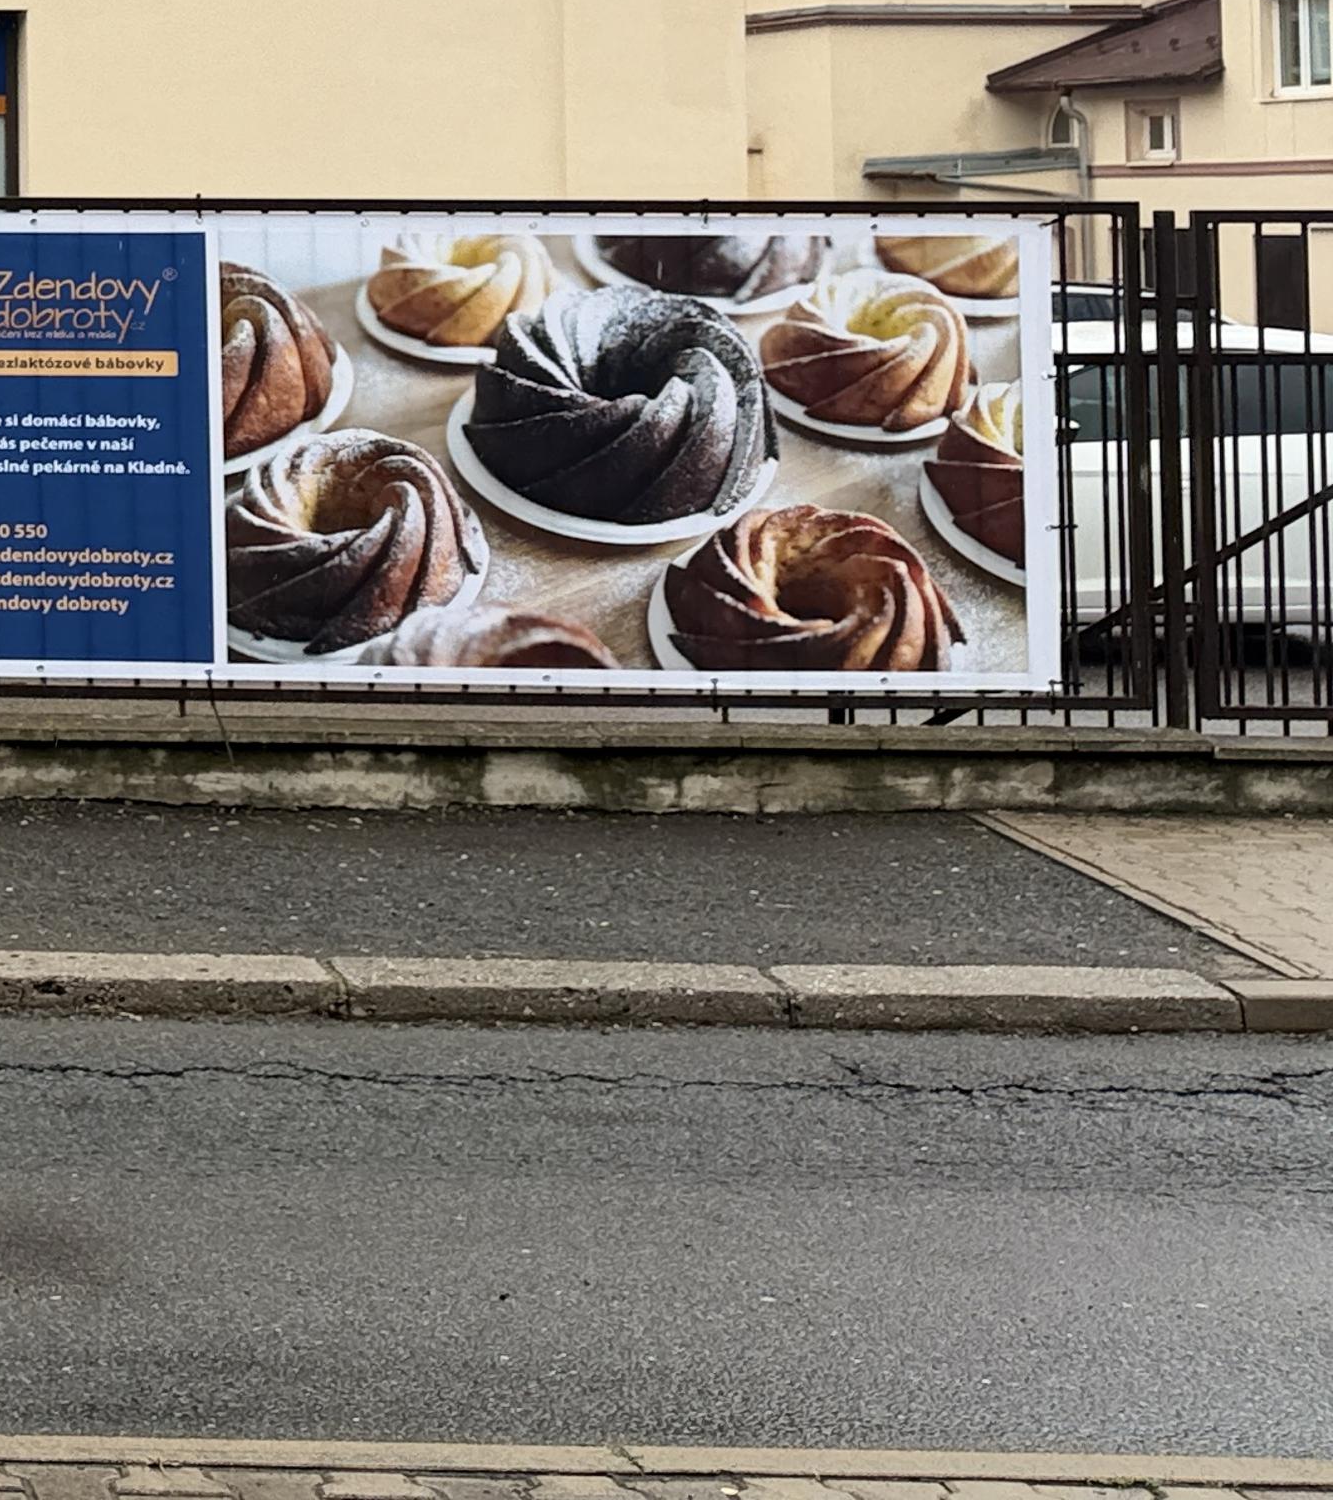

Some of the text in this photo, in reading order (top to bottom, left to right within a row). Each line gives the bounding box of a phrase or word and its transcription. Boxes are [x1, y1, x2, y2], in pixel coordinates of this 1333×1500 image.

[95, 356, 165, 372] bábovky
[5, 413, 19, 428] si
[21, 413, 83, 429] domácí
[85, 414, 161, 431] bábovky,
[19, 436, 84, 453] pečeme
[86, 440, 98, 451] v
[100, 437, 135, 451] naší
[32, 459, 101, 476] pekárně
[103, 463, 125, 475] na
[127, 460, 191, 476] Kladně.
[13, 523, 48, 539] 550
[55, 596, 130, 616] dobroty
